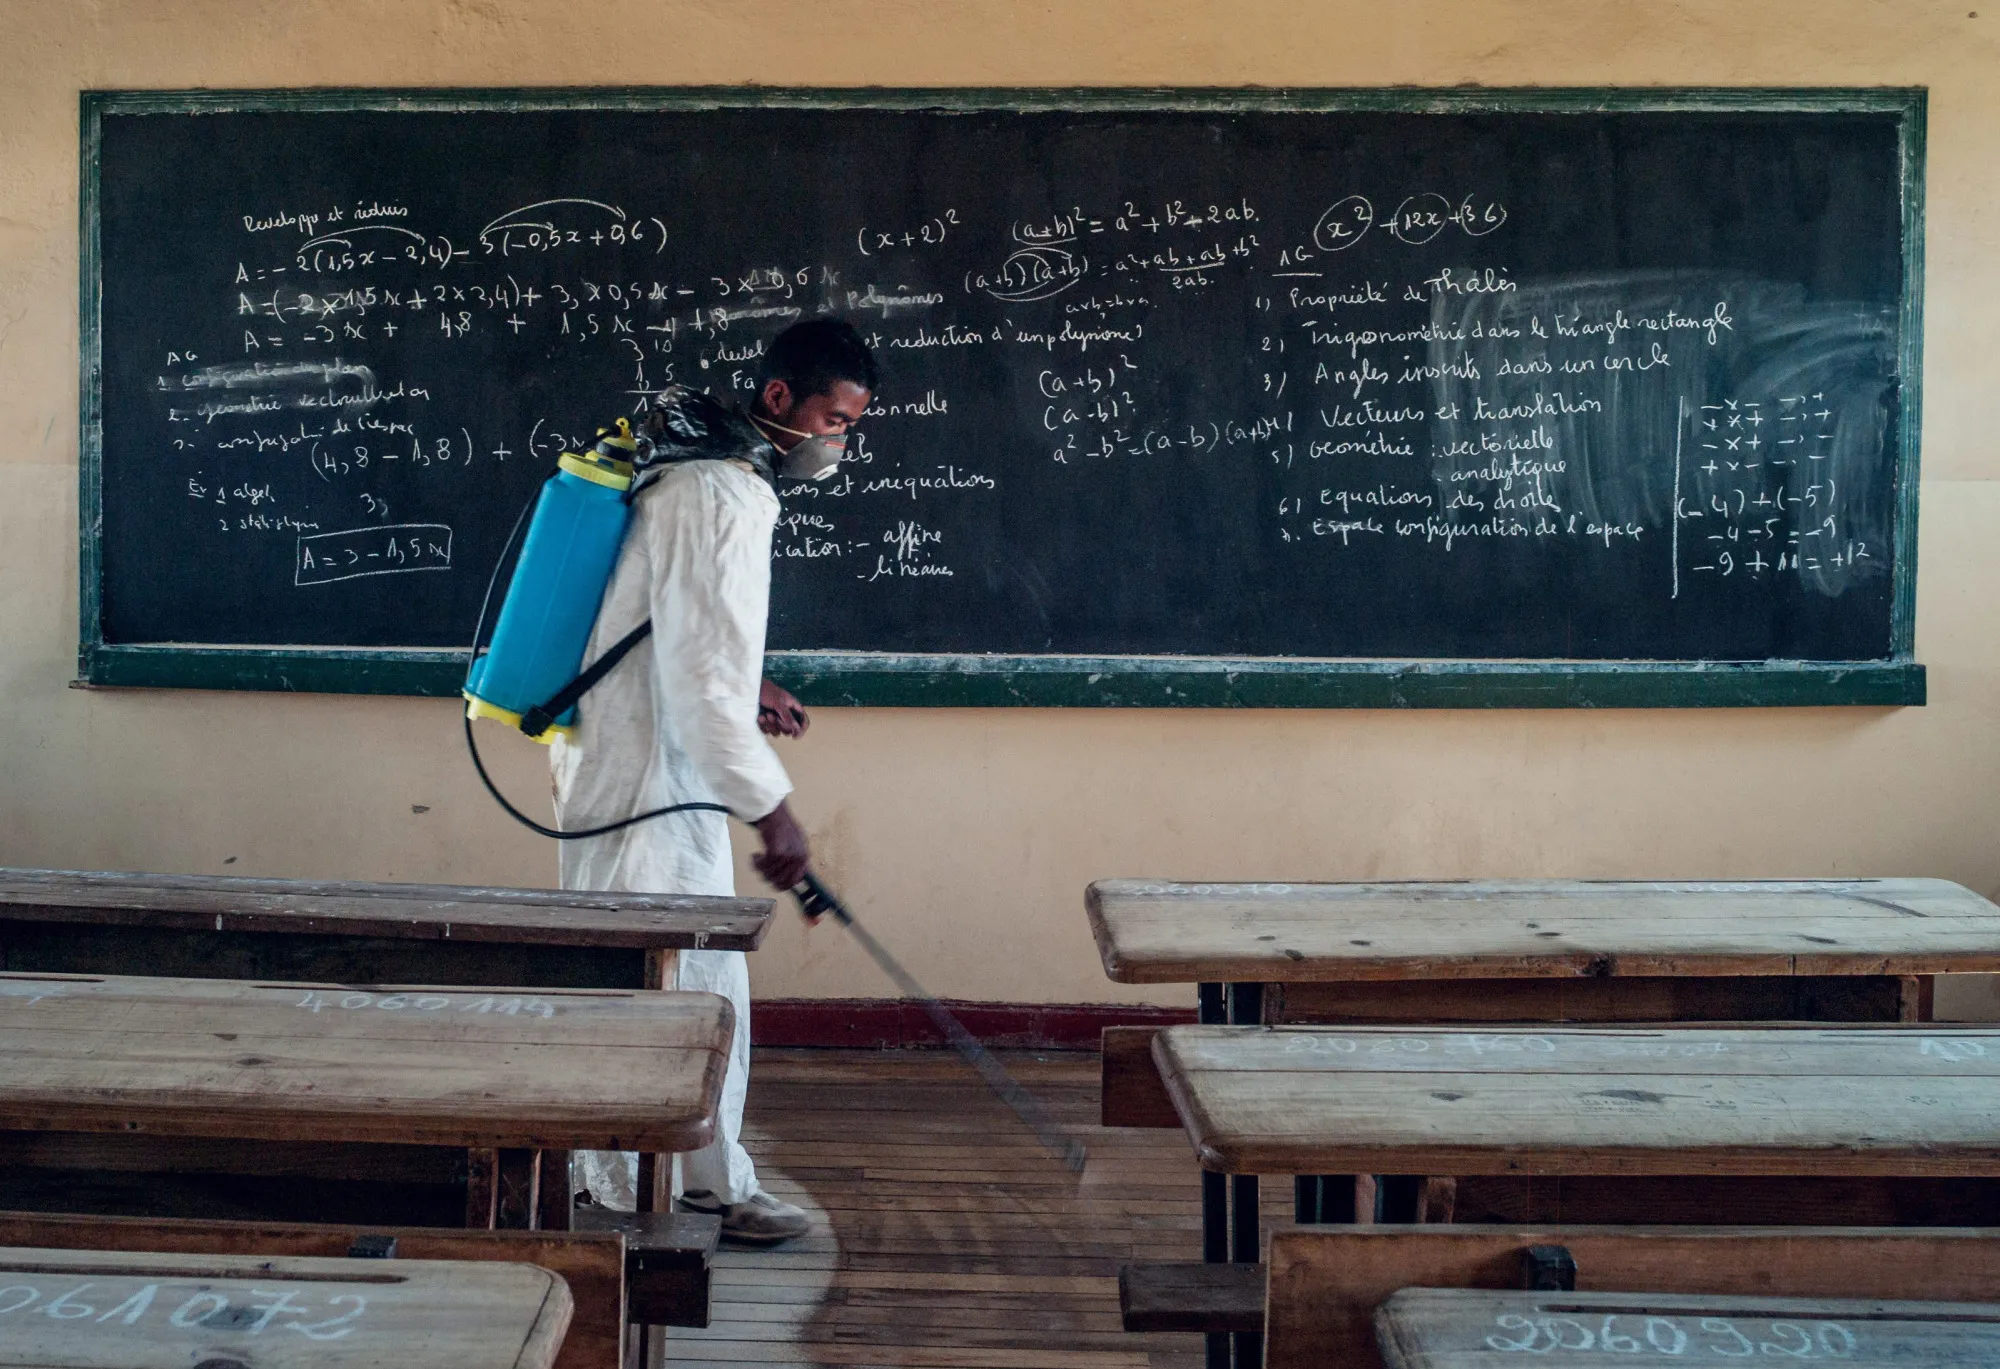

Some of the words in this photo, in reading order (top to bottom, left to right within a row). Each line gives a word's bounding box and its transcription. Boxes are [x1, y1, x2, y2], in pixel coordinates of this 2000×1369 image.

[327, 206, 344, 222] et
[235, 262, 250, 284] A
[1404, 285, 1428, 302] de
[1471, 320, 1521, 340] dans
[1532, 316, 1549, 339] le
[1555, 308, 1631, 345] triangle
[1637, 301, 1734, 345] rectangle
[1315, 358, 1390, 400] Angles
[1497, 352, 1552, 377] dans
[1560, 358, 1596, 374] un
[1604, 343, 1671, 371] cercle
[1320, 398, 1425, 429] Vecteurs
[1434, 401, 1461, 421] et
[825, 474, 855, 497] et
[1446, 491, 1485, 513] des
[1535, 516, 1558, 536] de
[883, 520, 943, 561] affine
